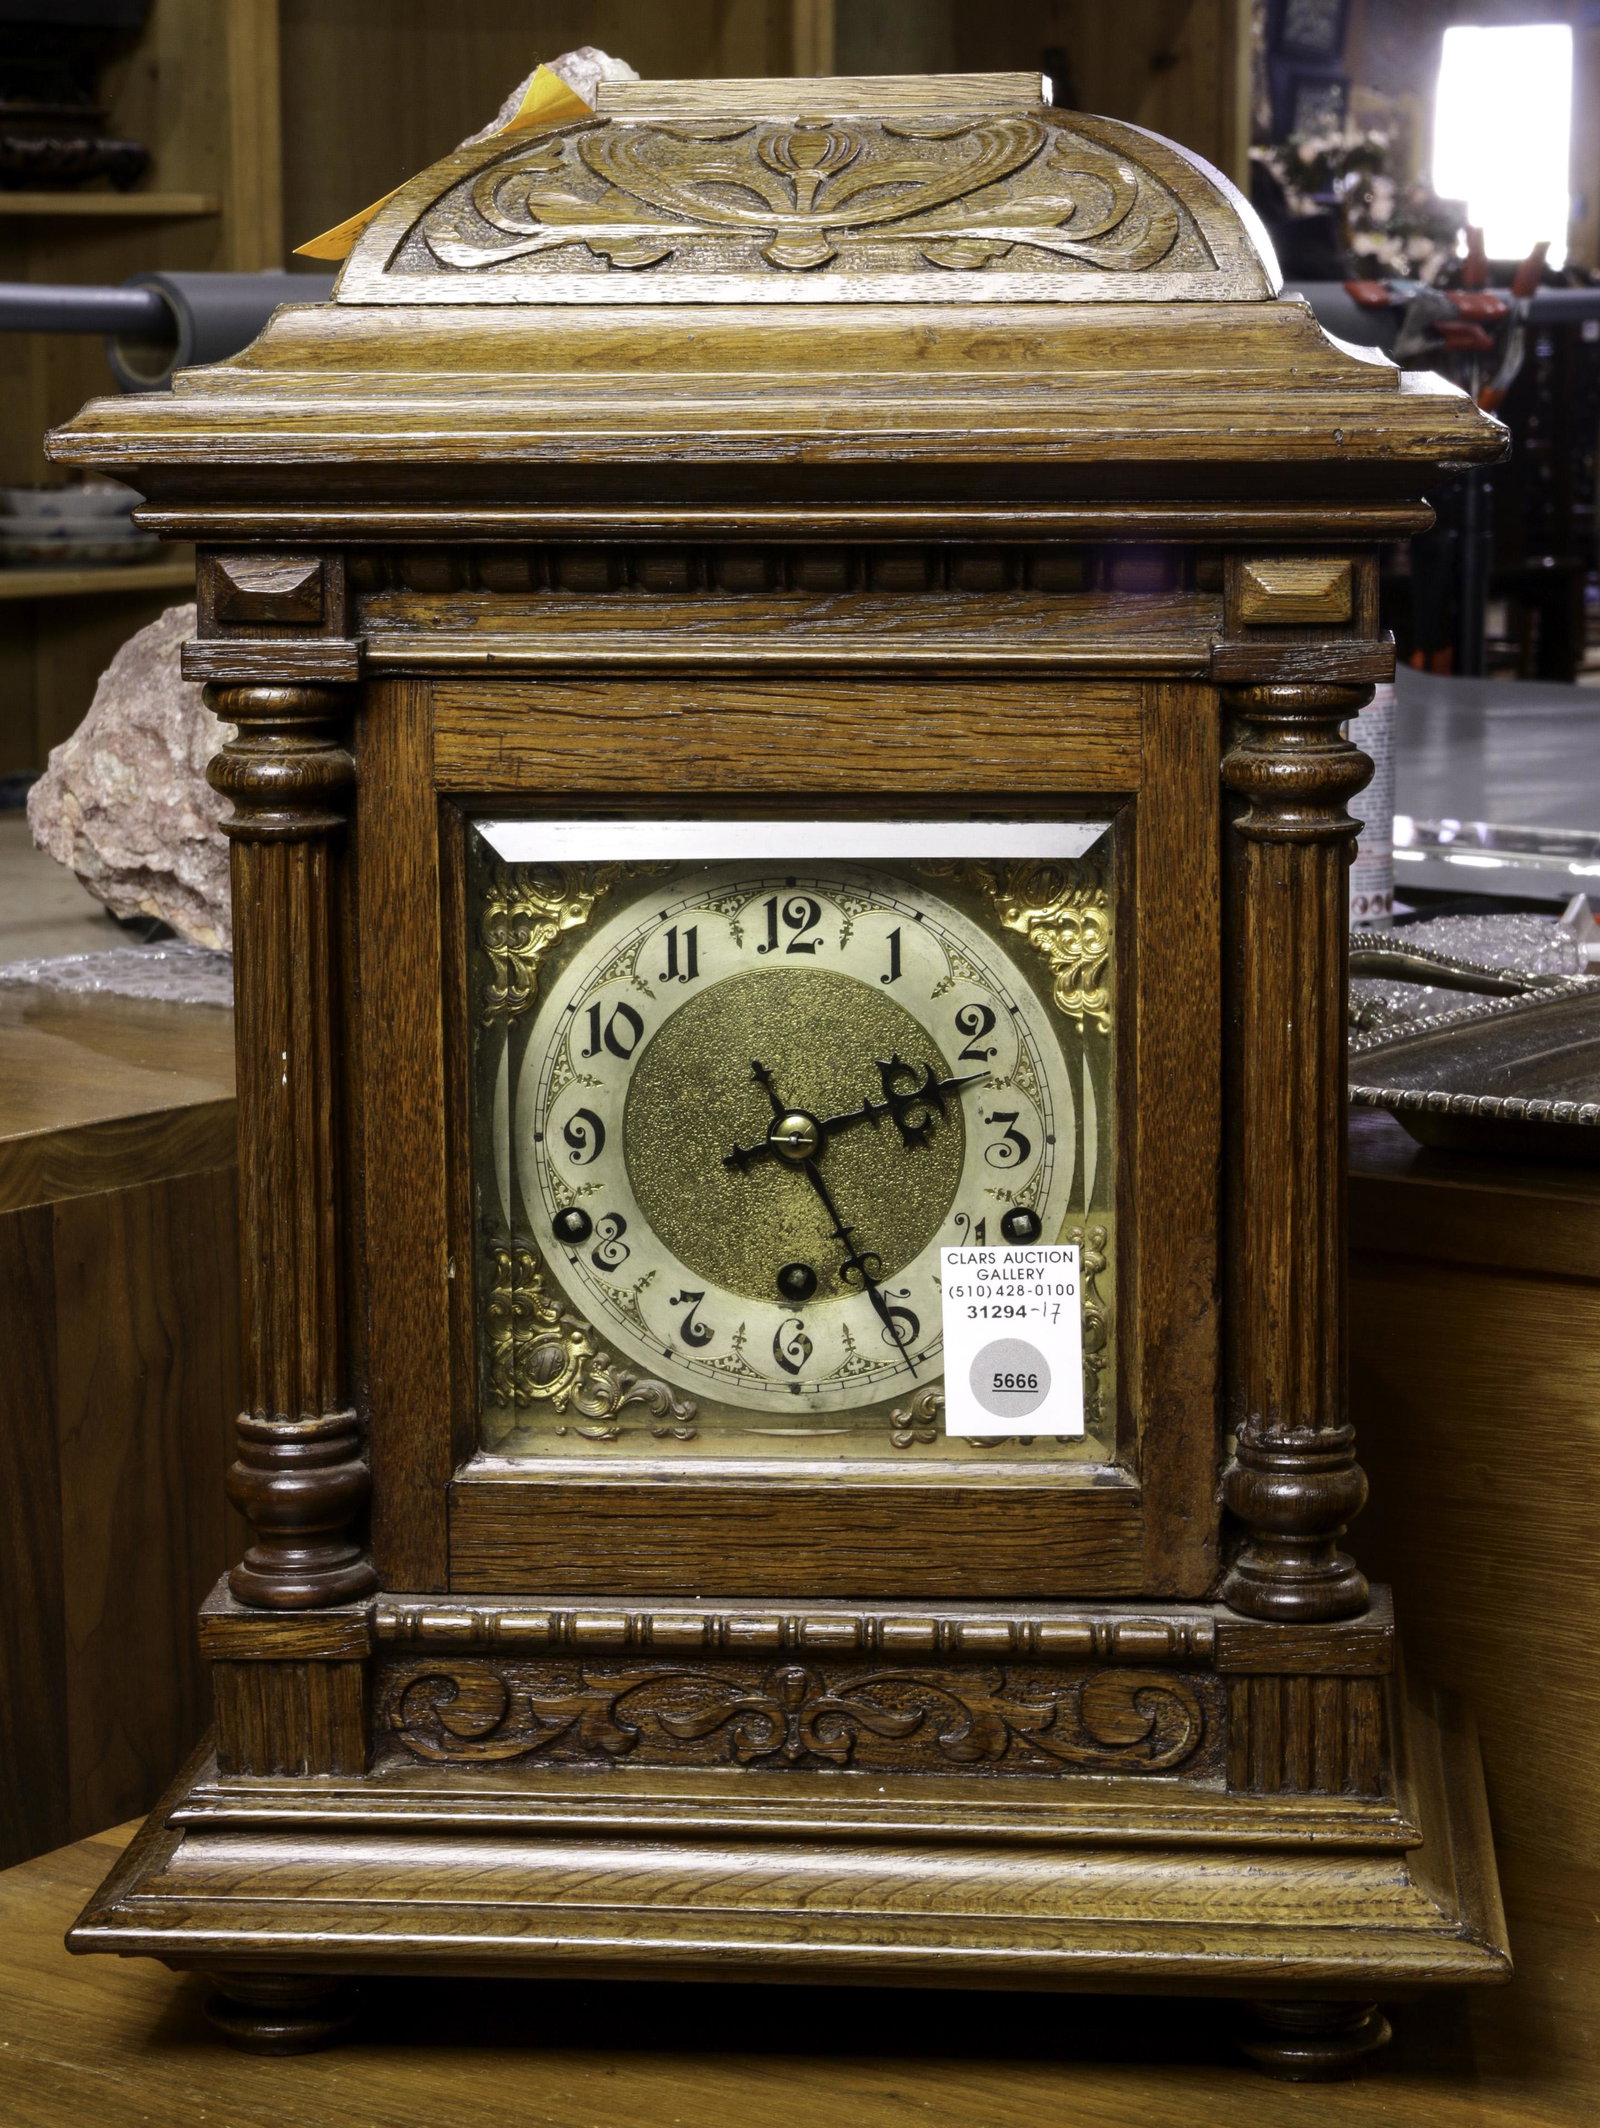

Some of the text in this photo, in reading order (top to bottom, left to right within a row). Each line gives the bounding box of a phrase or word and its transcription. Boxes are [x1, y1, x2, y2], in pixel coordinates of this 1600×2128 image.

[659, 925, 700, 983] 11
[757, 896, 823, 954] 12
[881, 927, 903, 985] 1
[581, 1001, 645, 1059] 10
[955, 1004, 998, 1061] 2
[563, 1107, 606, 1165] 9
[984, 1111, 1031, 1169] 3
[591, 1212, 631, 1272] 8
[948, 1251, 1073, 1265] CLARS AUCTION
[977, 1268, 1045, 1280] GALLERY
[669, 1291, 714, 1347] 7
[772, 1318, 814, 1375] 6
[881, 1288, 920, 1347] 5
[993, 1373, 1038, 1389] 5666
